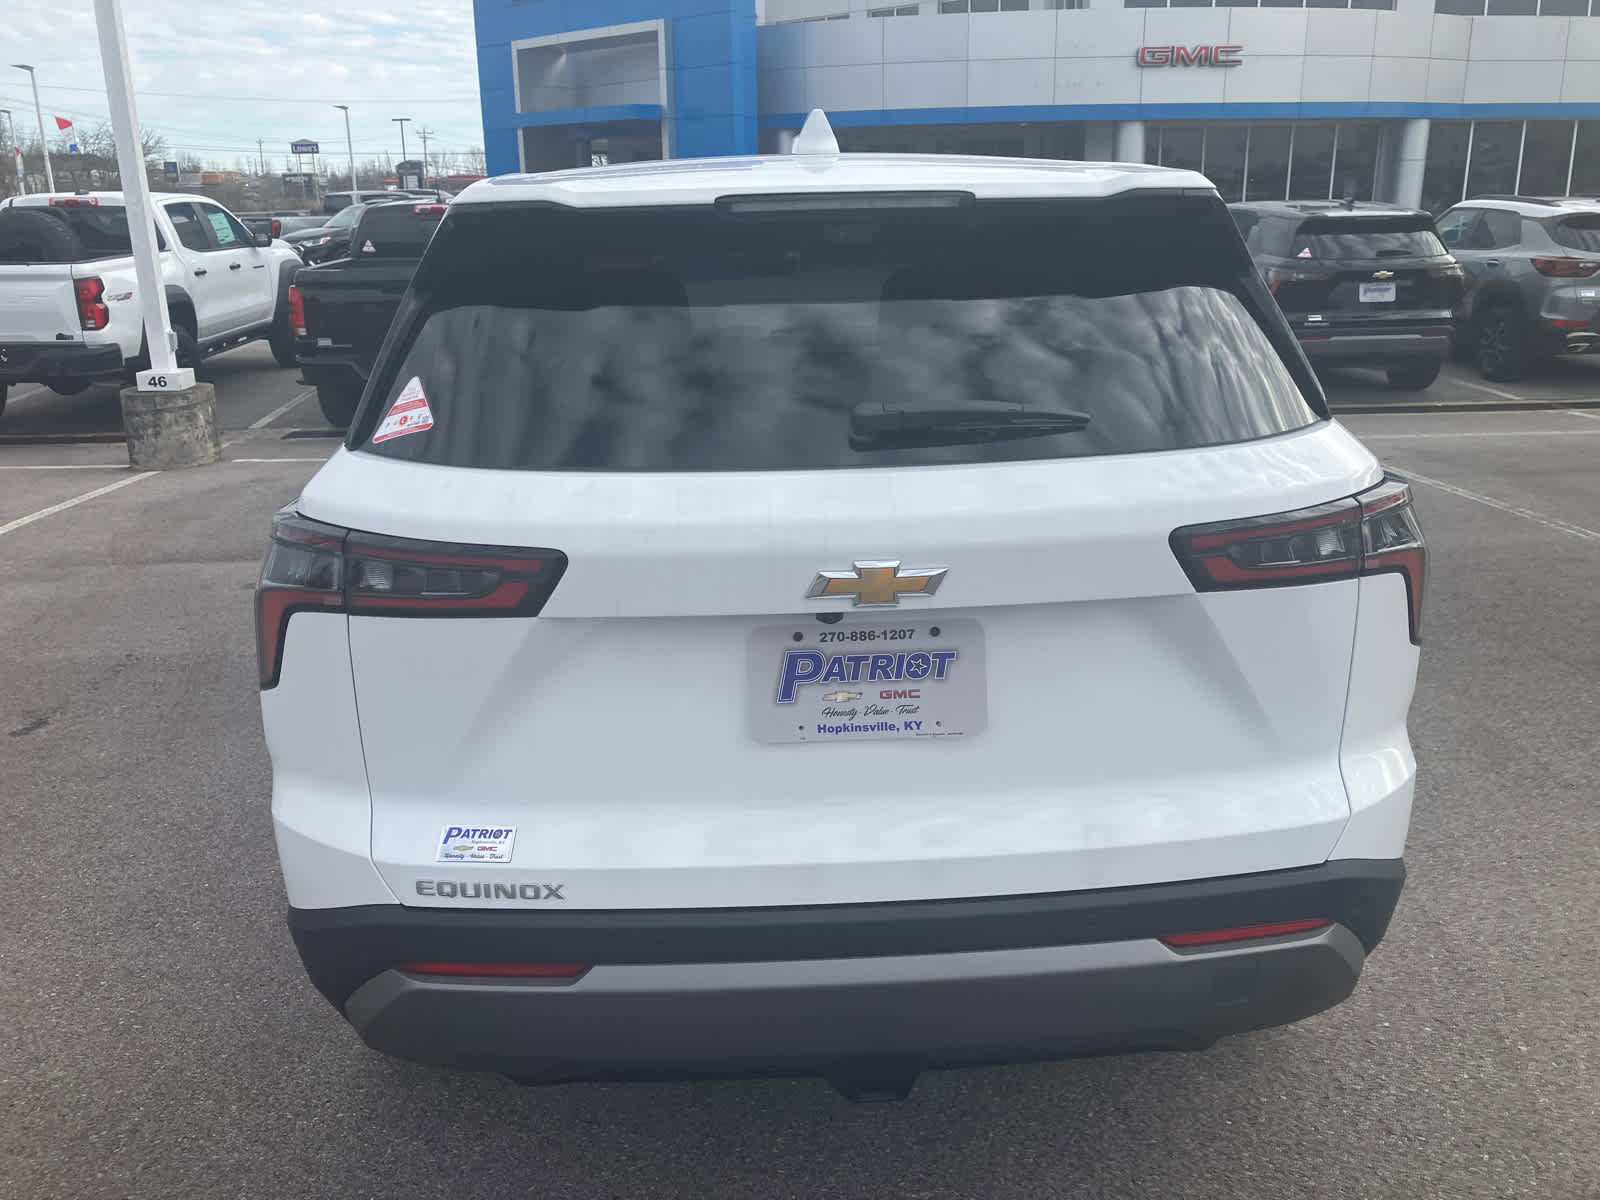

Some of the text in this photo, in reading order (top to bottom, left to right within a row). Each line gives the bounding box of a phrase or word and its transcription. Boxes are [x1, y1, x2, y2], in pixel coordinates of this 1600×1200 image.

[1137, 45, 1243, 67] GMC
[148, 376, 167, 387] 46
[819, 629, 915, 643] 270-886-1207
[776, 648, 958, 704] PATRIOT
[879, 689, 921, 699] GMC
[895, 704, 920, 716] Trust
[817, 720, 923, 735] Hopkinsville, KY
[442, 826, 513, 845] PATRIOT
[415, 880, 566, 900] EQUINOX
